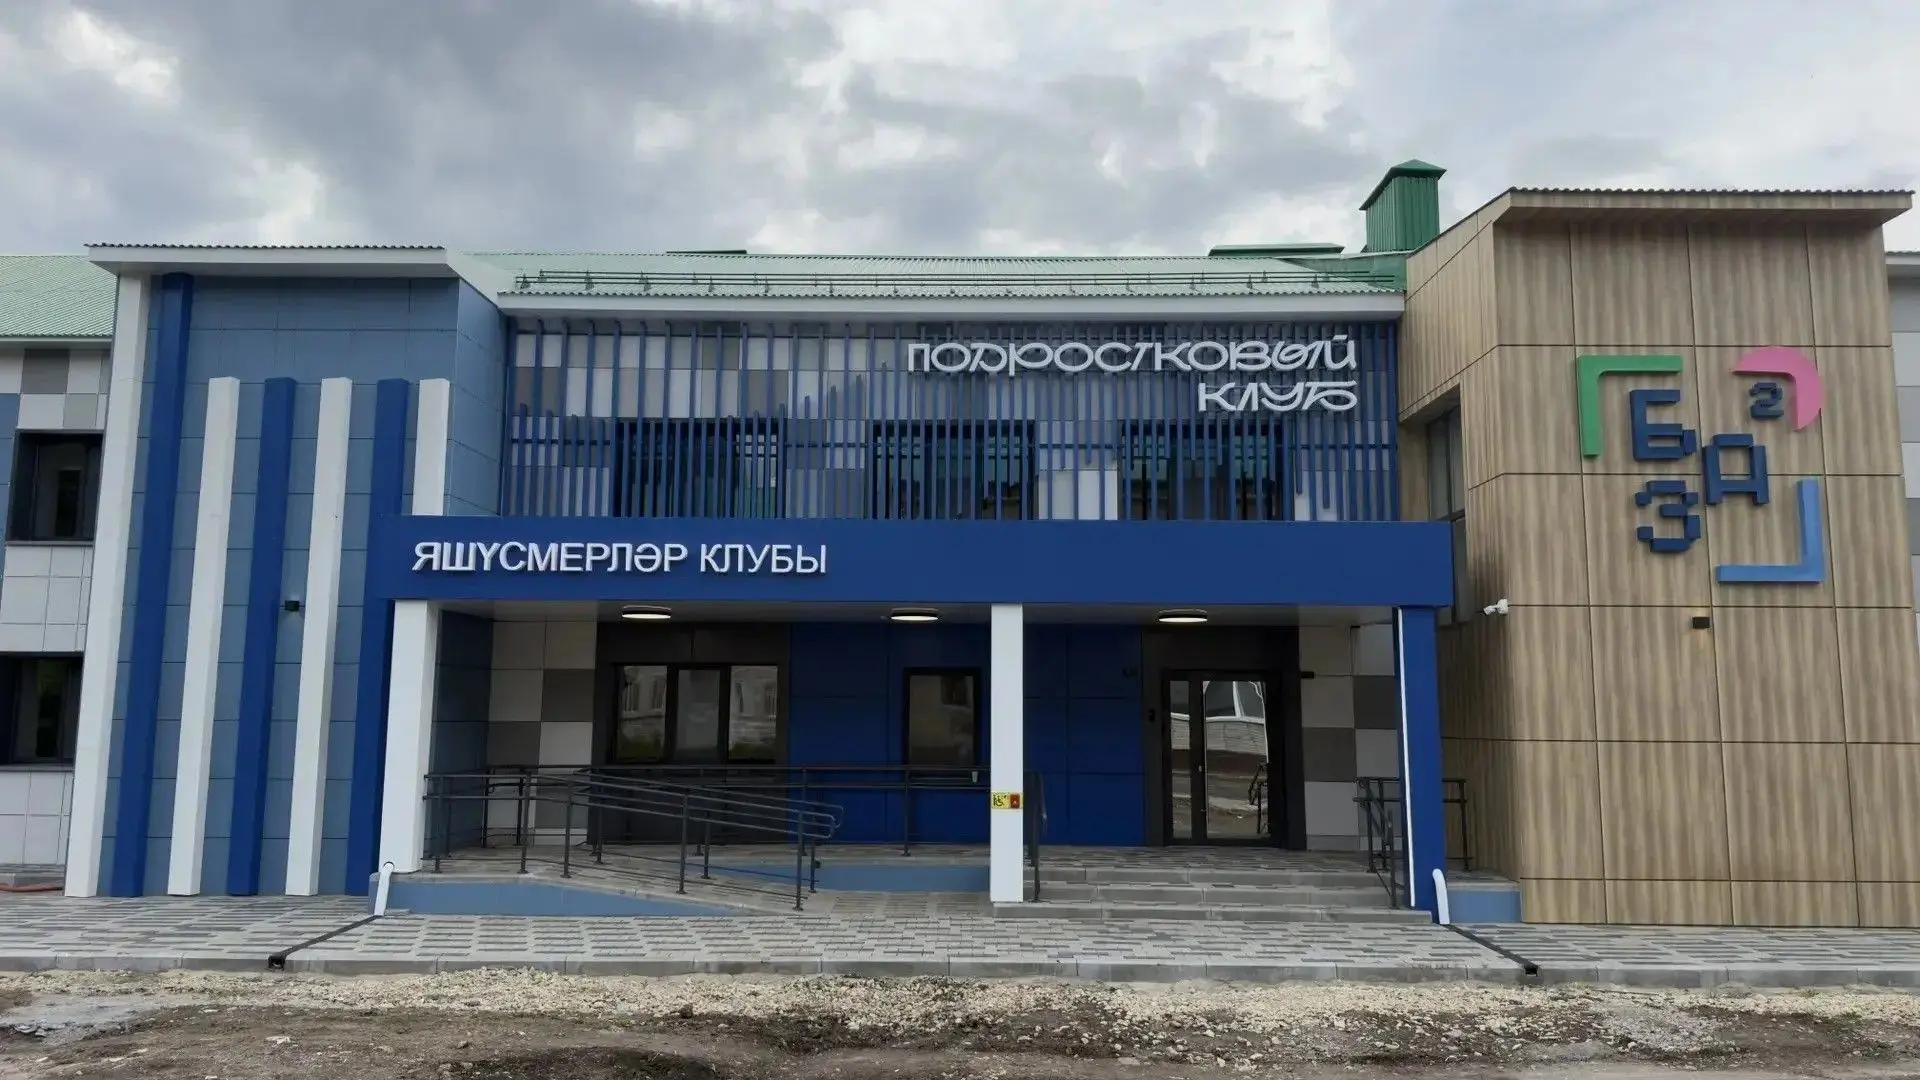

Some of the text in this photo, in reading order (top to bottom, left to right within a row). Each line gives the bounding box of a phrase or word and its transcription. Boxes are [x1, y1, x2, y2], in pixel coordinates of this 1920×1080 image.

[907, 334, 1357, 377] ПОДРОСТКОВЫЙ
[1198, 380, 1358, 412] КЛУБ
[700, 544, 828, 574] КЛУБЫ
